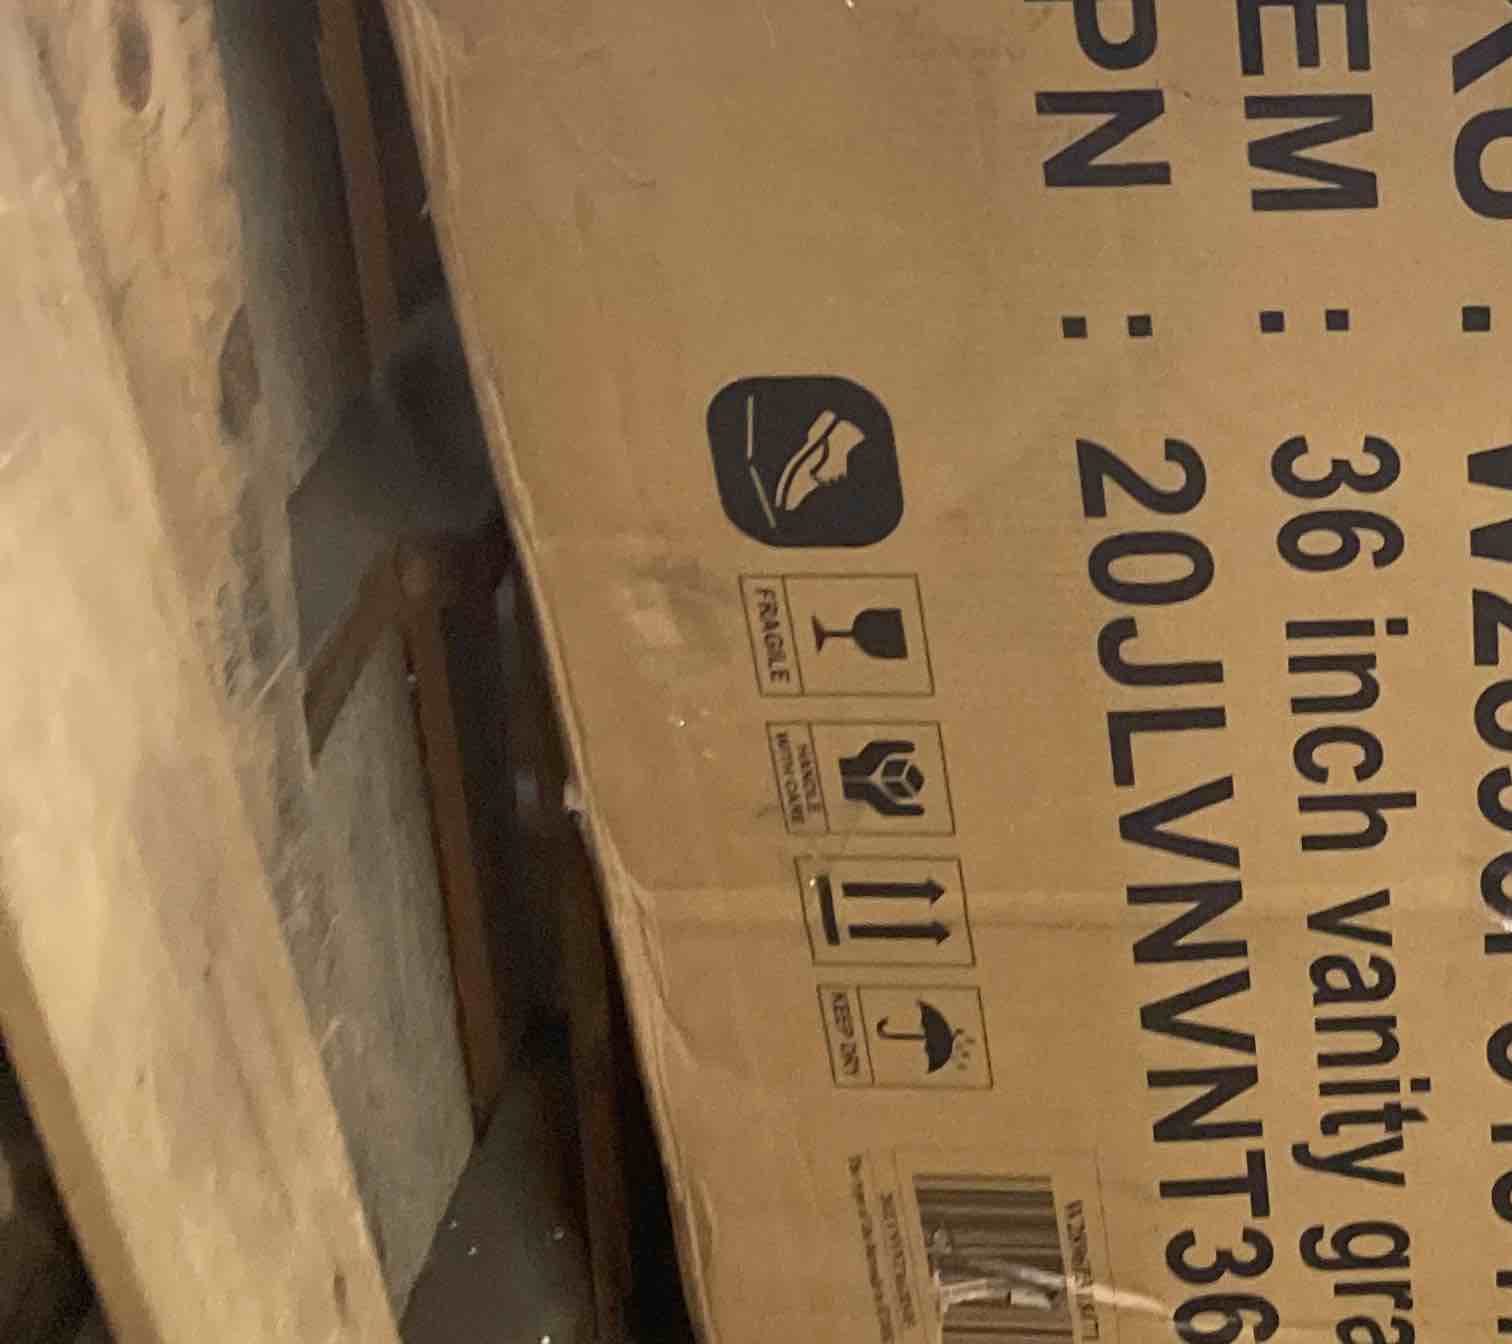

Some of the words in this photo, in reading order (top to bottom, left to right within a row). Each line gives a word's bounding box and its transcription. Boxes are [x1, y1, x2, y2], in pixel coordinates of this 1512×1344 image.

[1063, 314, 1153, 339] :
[1260, 309, 1349, 333] :
[1272, 436, 1405, 572] 36
[755, 586, 790, 683] FRAGILE
[776, 732, 796, 775] WITH
[1286, 619, 1417, 852] inch
[785, 778, 807, 825] CARE
[799, 743, 822, 814] HANDLE
[831, 991, 854, 1038] KEEP
[1292, 889, 1431, 1186] vanity
[838, 1041, 861, 1077] DRY
